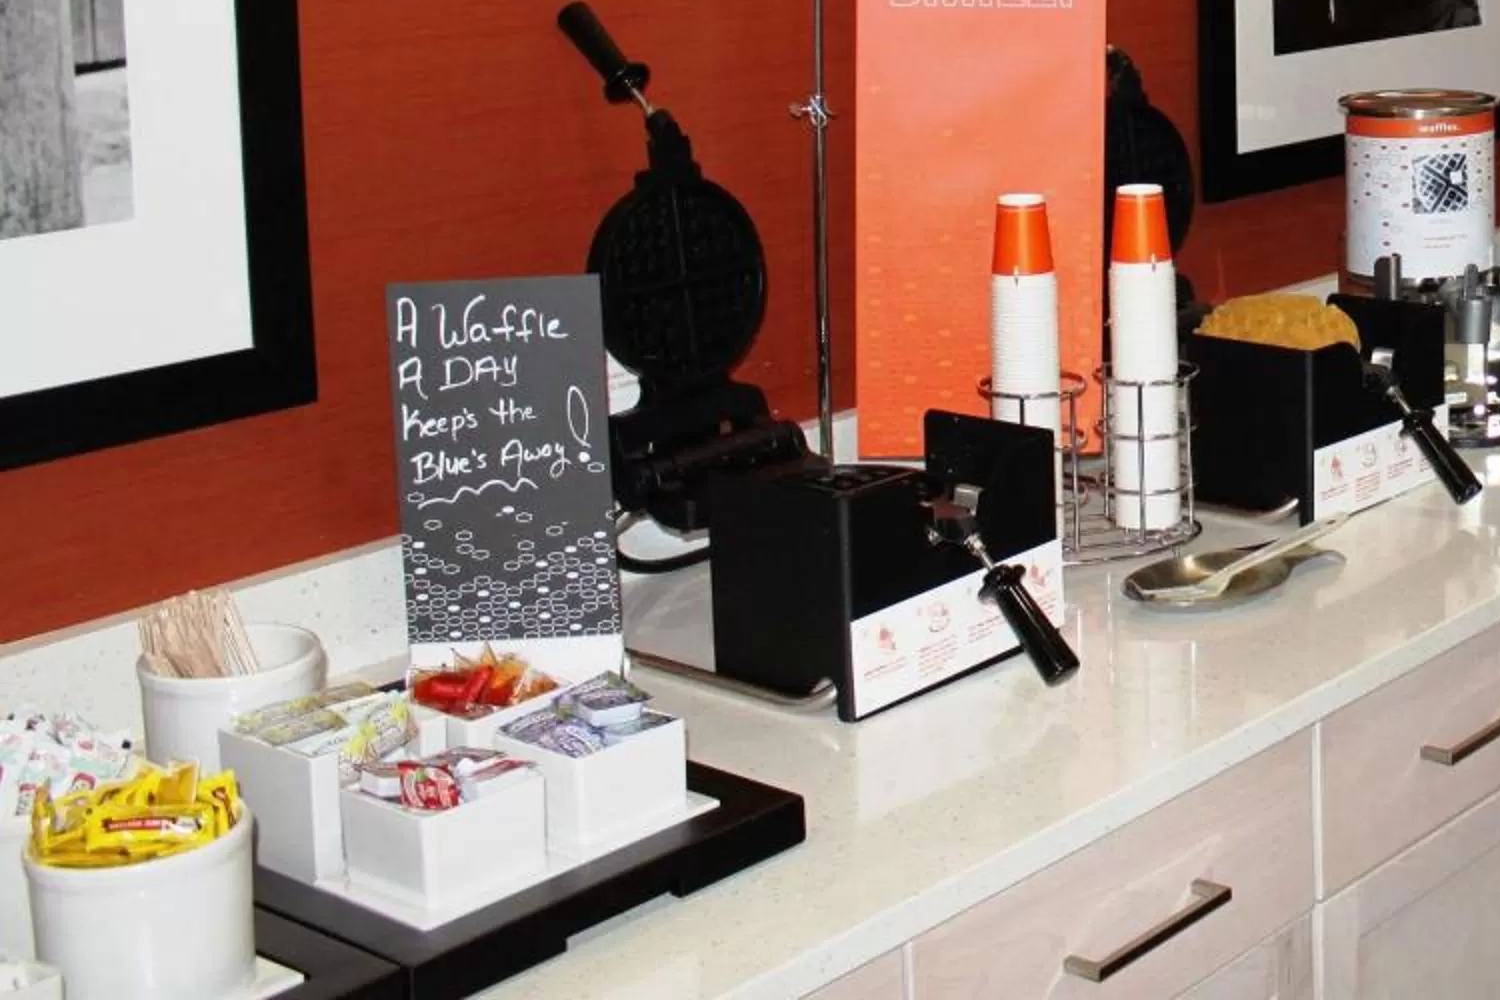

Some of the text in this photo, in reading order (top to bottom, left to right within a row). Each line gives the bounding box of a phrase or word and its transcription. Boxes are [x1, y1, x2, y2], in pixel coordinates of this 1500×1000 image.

[397, 295, 568, 349] A Waffle
[399, 355, 518, 399] A DAY
[489, 398, 536, 425] the
[410, 449, 487, 485] Blue's
